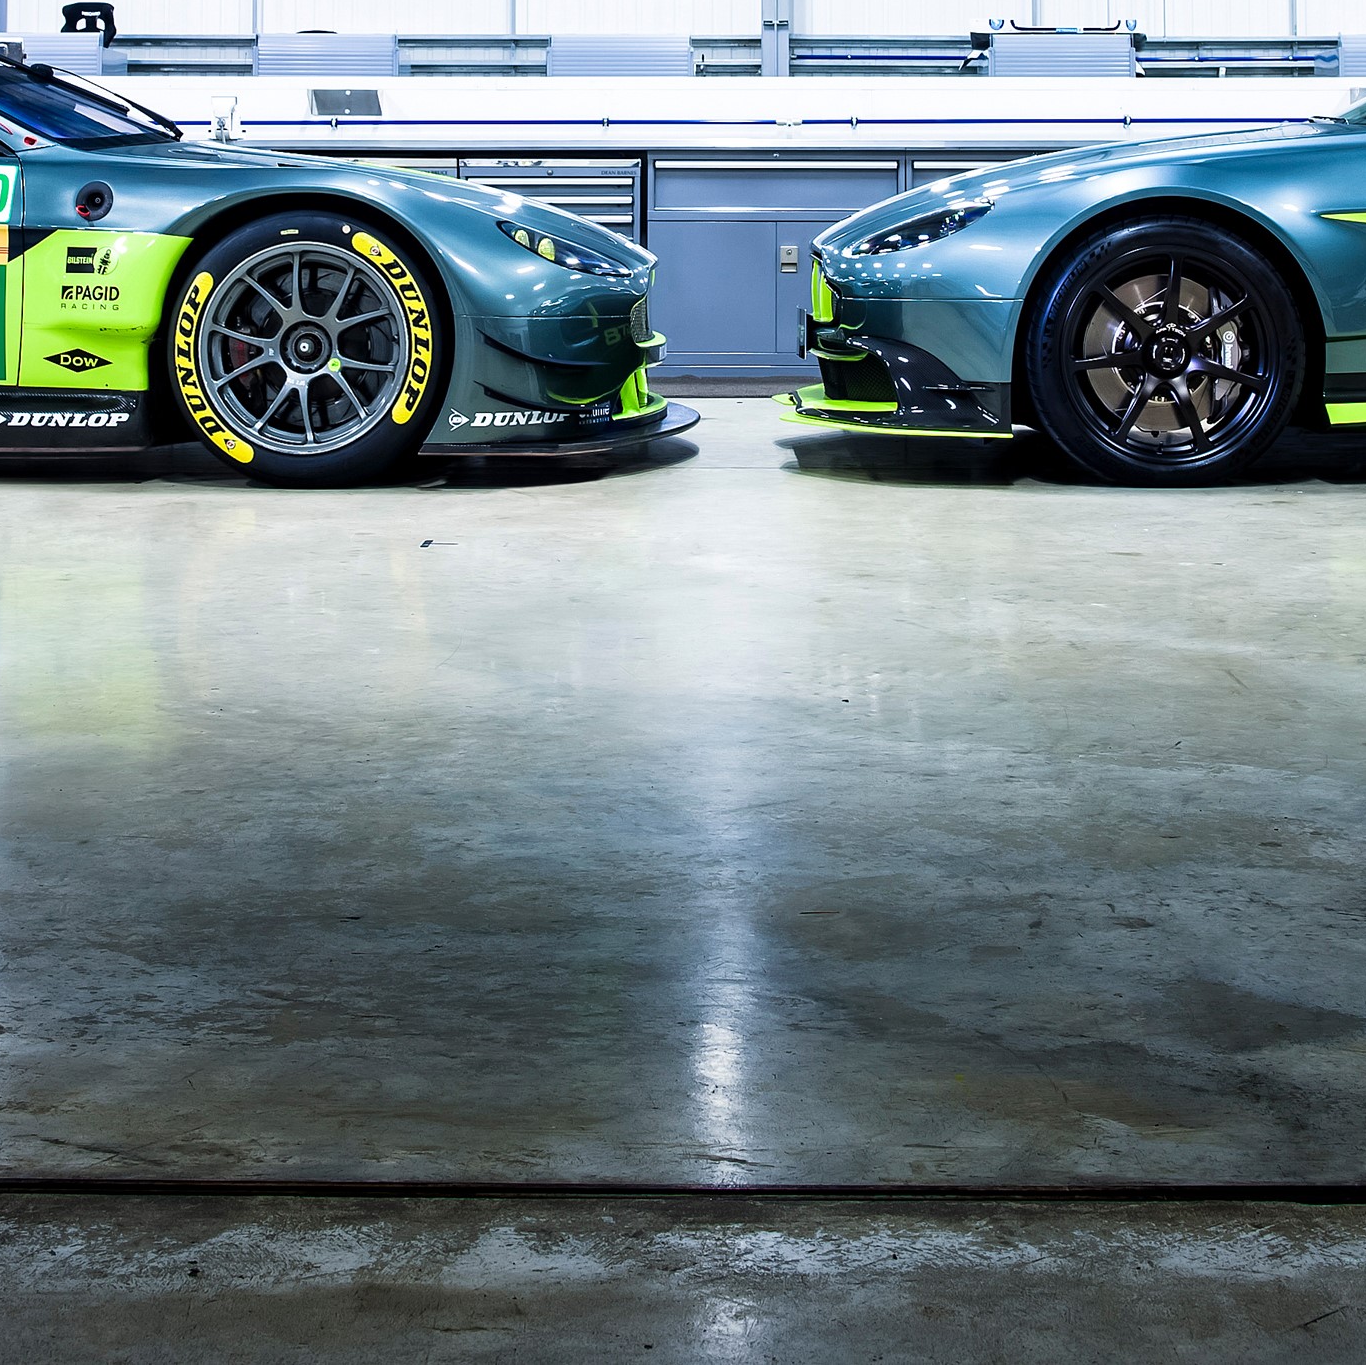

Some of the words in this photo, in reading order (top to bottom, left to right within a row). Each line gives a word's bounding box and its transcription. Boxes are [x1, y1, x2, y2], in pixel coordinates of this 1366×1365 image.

[75, 285, 120, 301] PAGID
[60, 303, 120, 311] RACING
[380, 249, 430, 412] DUNLOP
[177, 285, 226, 437] DUNLOP
[7, 412, 130, 427] DUNLOP
